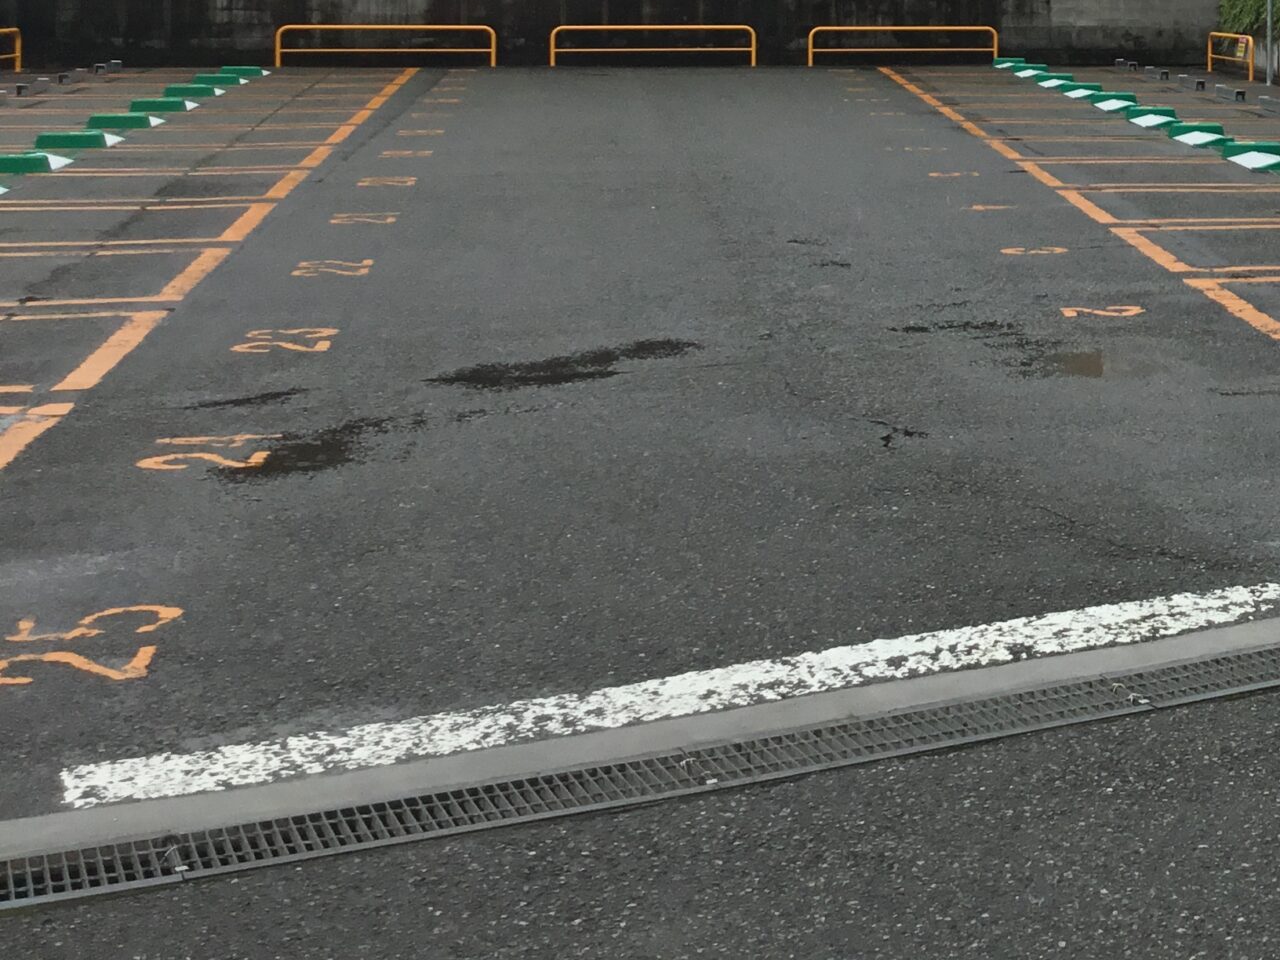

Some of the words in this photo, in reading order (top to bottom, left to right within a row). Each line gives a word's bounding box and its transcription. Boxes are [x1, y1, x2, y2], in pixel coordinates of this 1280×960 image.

[290, 259, 374, 276] 22
[1060, 305, 1146, 318] 2
[230, 327, 340, 352] 23
[136, 433, 283, 470] 24
[0, 604, 185, 685] 25
